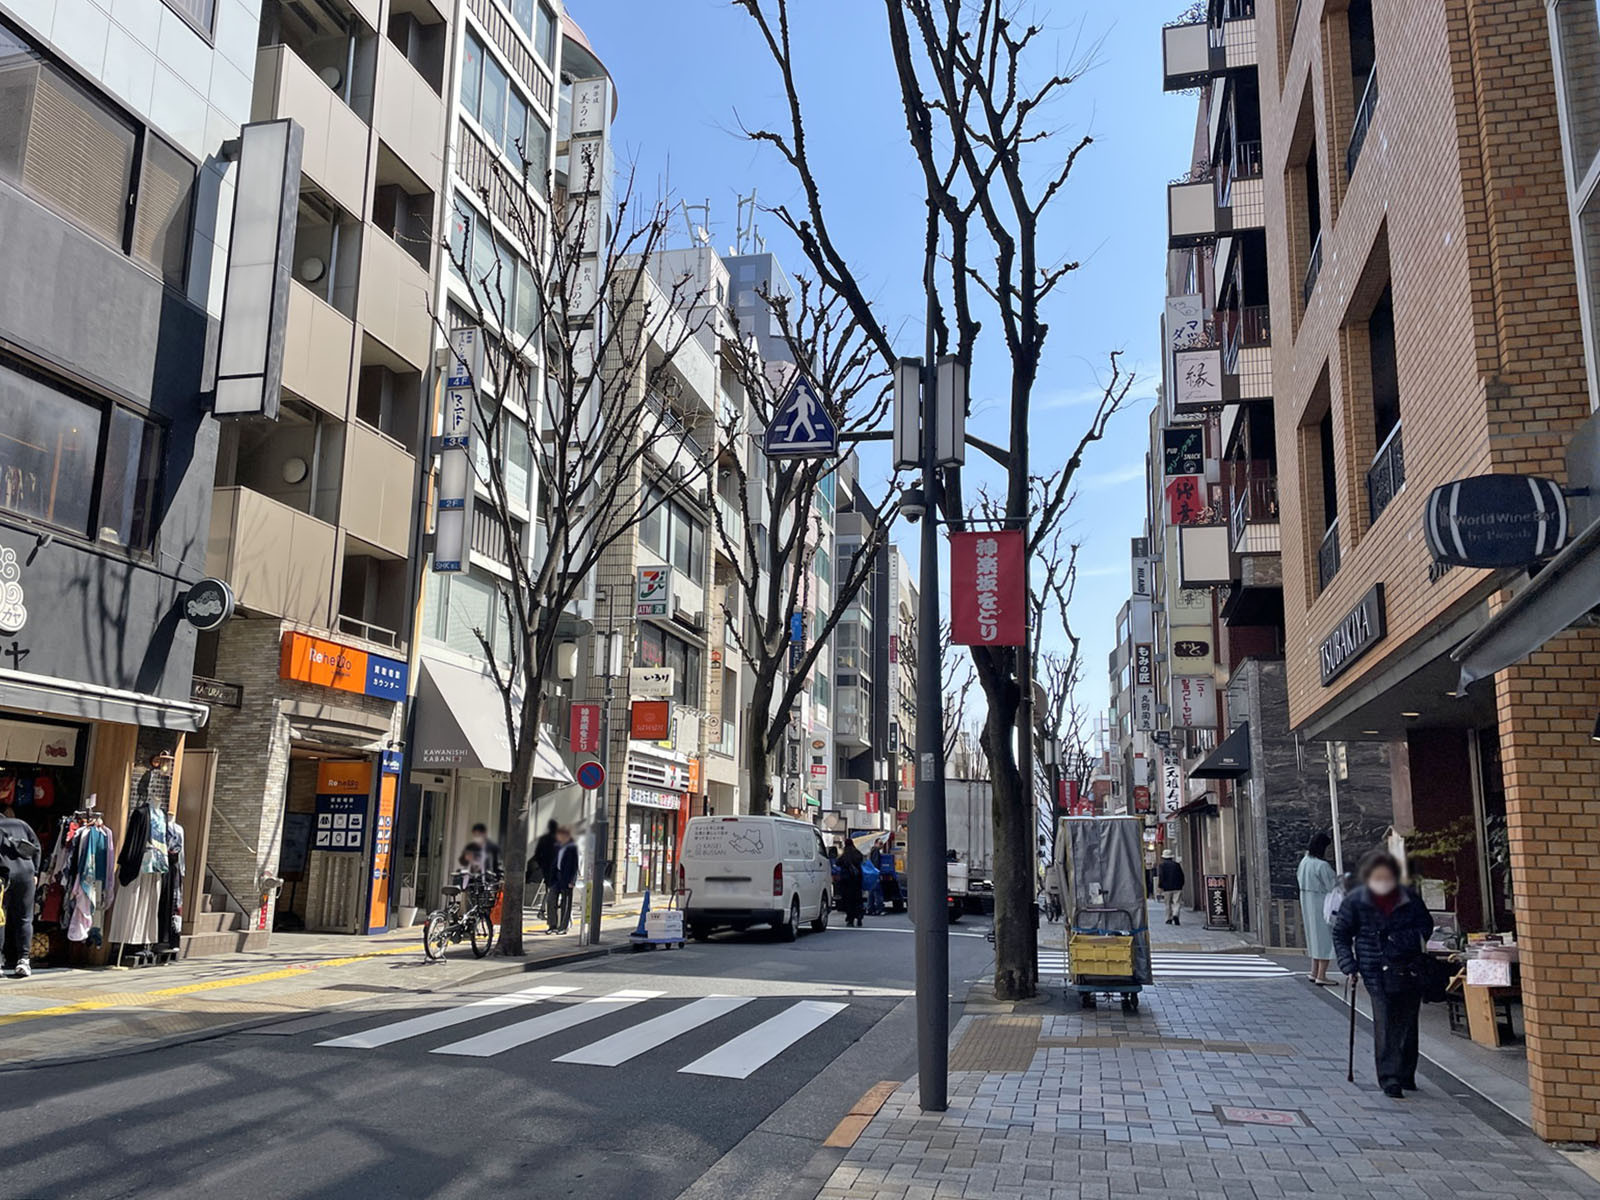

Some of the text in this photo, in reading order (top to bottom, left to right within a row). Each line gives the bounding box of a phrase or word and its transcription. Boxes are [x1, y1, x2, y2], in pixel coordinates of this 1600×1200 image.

[453, 379, 468, 387] 4F
[446, 500, 459, 508] 2F
[1320, 602, 1370, 677] TSUBAKIYA
[643, 673, 669, 683] いろり
[373, 678, 400, 689] カウンター
